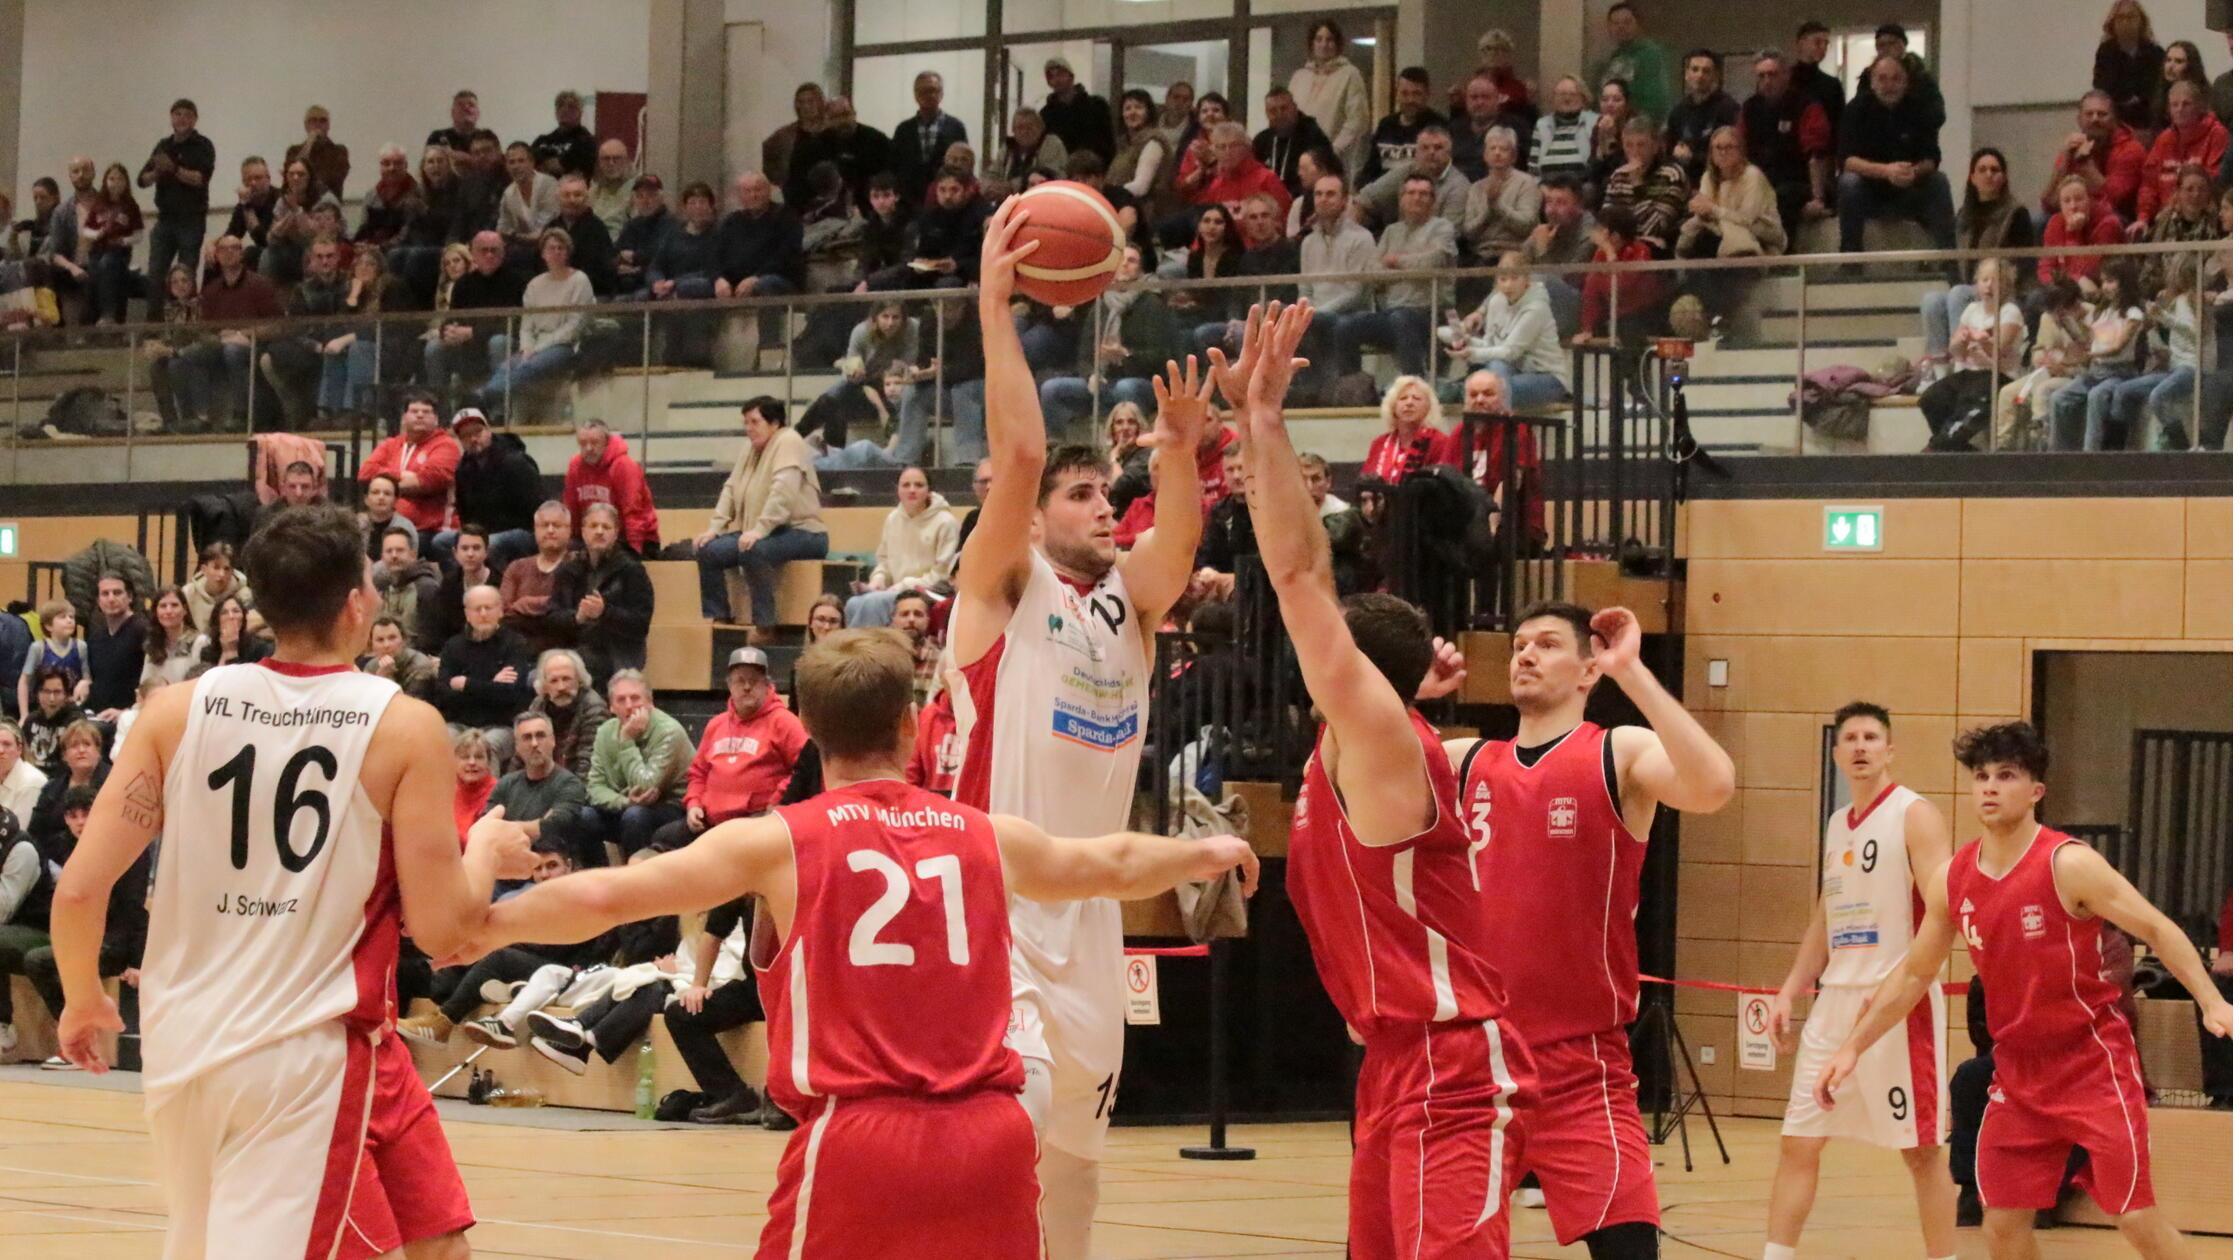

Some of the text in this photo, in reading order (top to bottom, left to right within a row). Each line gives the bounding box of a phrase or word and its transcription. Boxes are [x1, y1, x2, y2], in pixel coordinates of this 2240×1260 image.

[204, 695, 370, 729] VfL Treuchtlingen
[207, 743, 338, 873] 16
[827, 804, 966, 831] MTV München
[1862, 839, 1878, 873] 9
[216, 893, 231, 914] J.
[846, 849, 970, 967] 21
[1888, 1086, 1907, 1120] 9
